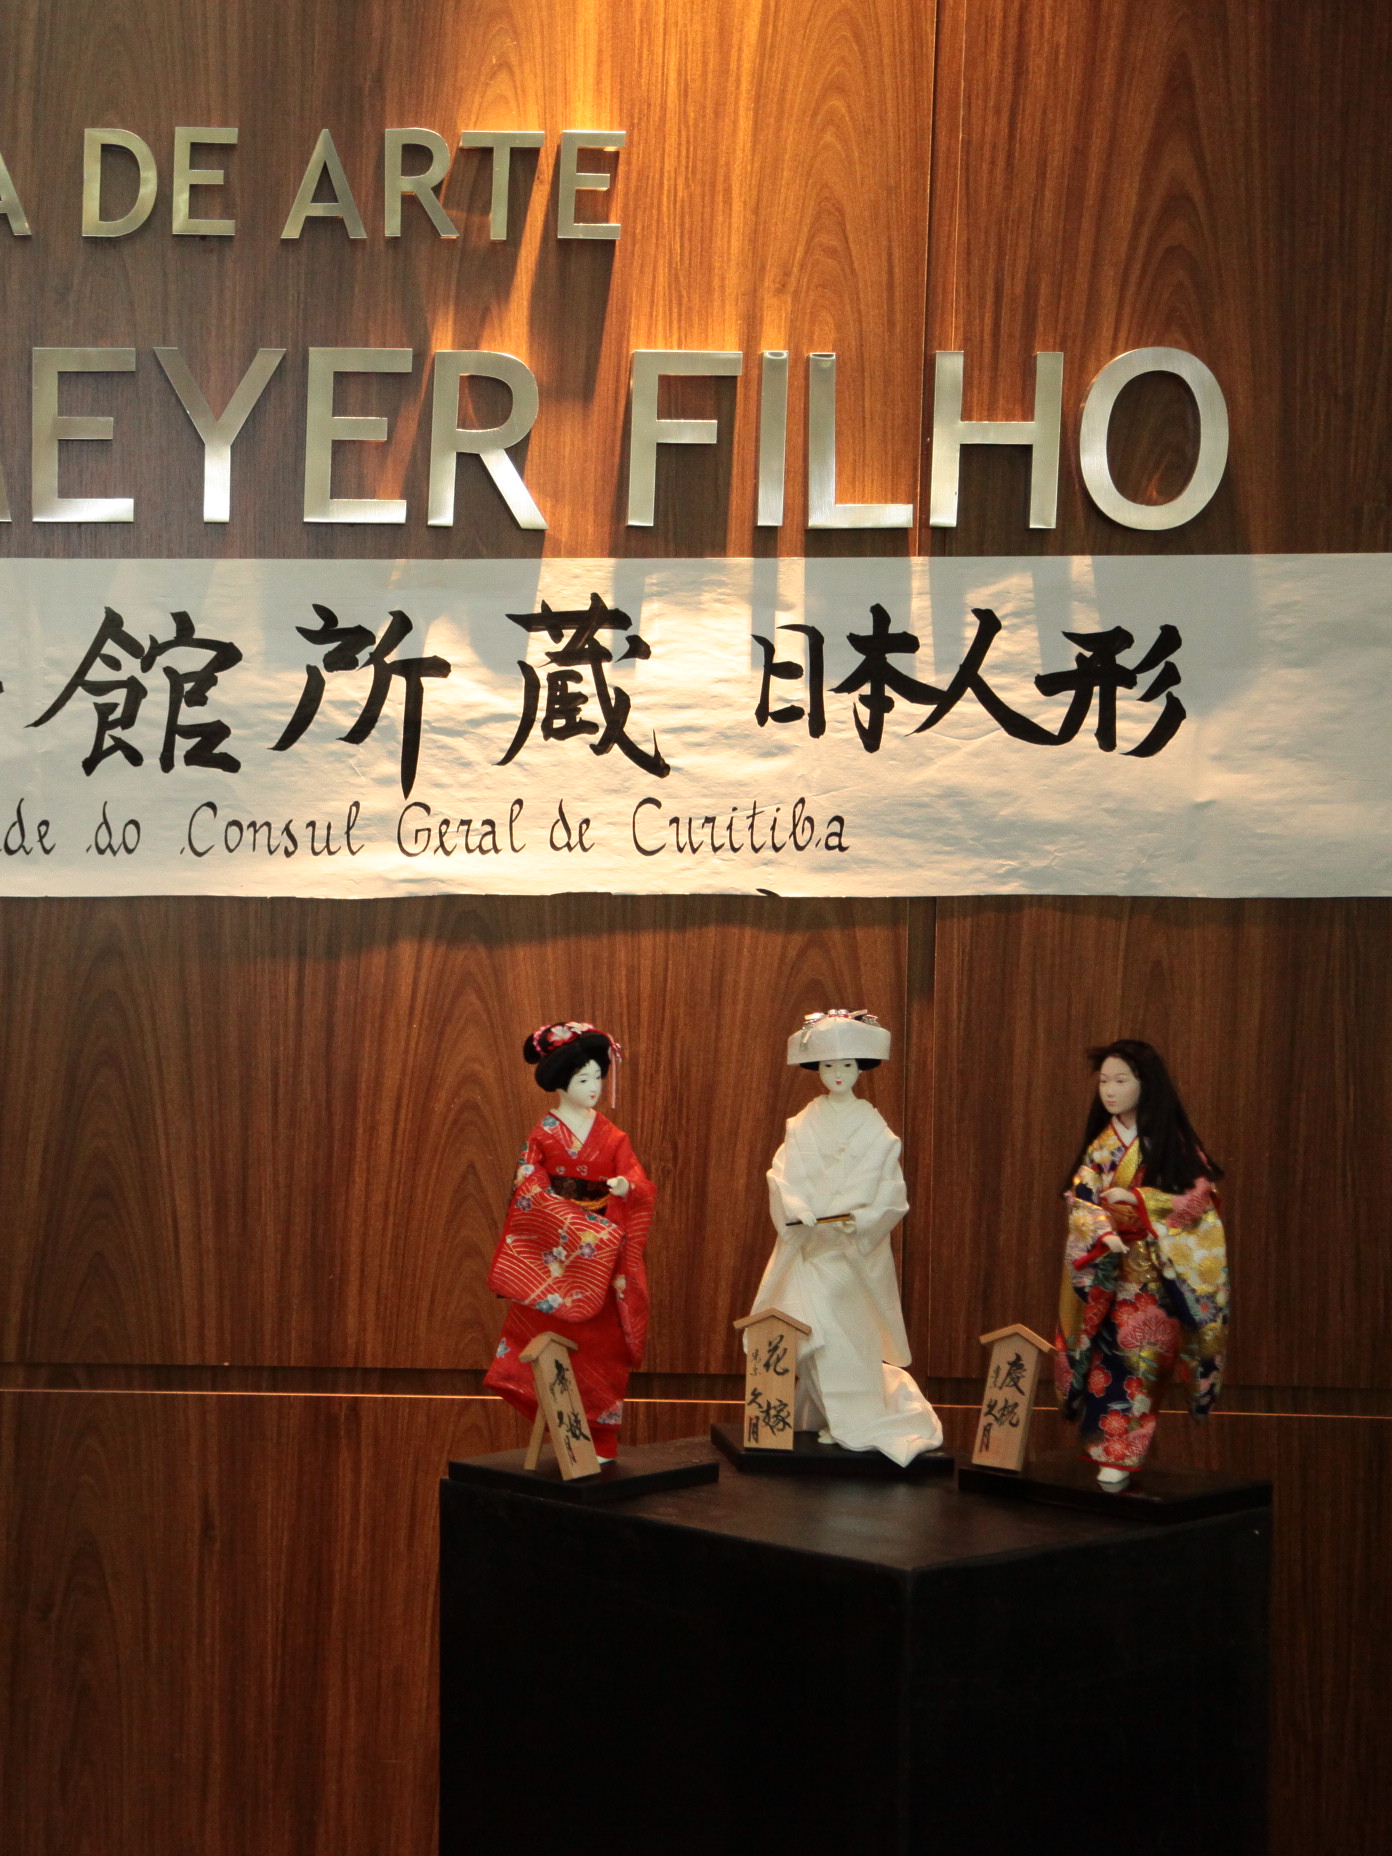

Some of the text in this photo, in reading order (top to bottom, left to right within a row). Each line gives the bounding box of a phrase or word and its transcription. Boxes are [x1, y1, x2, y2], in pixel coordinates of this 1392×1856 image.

[82, 127, 238, 237] DE
[282, 127, 626, 240] ARTE
[625, 345, 1230, 532] FILHO
[87, 801, 140, 856] do
[181, 801, 364, 857] Consul
[397, 799, 525, 856] Geral
[549, 799, 594, 853] de
[633, 798, 849, 855] Curitiba
